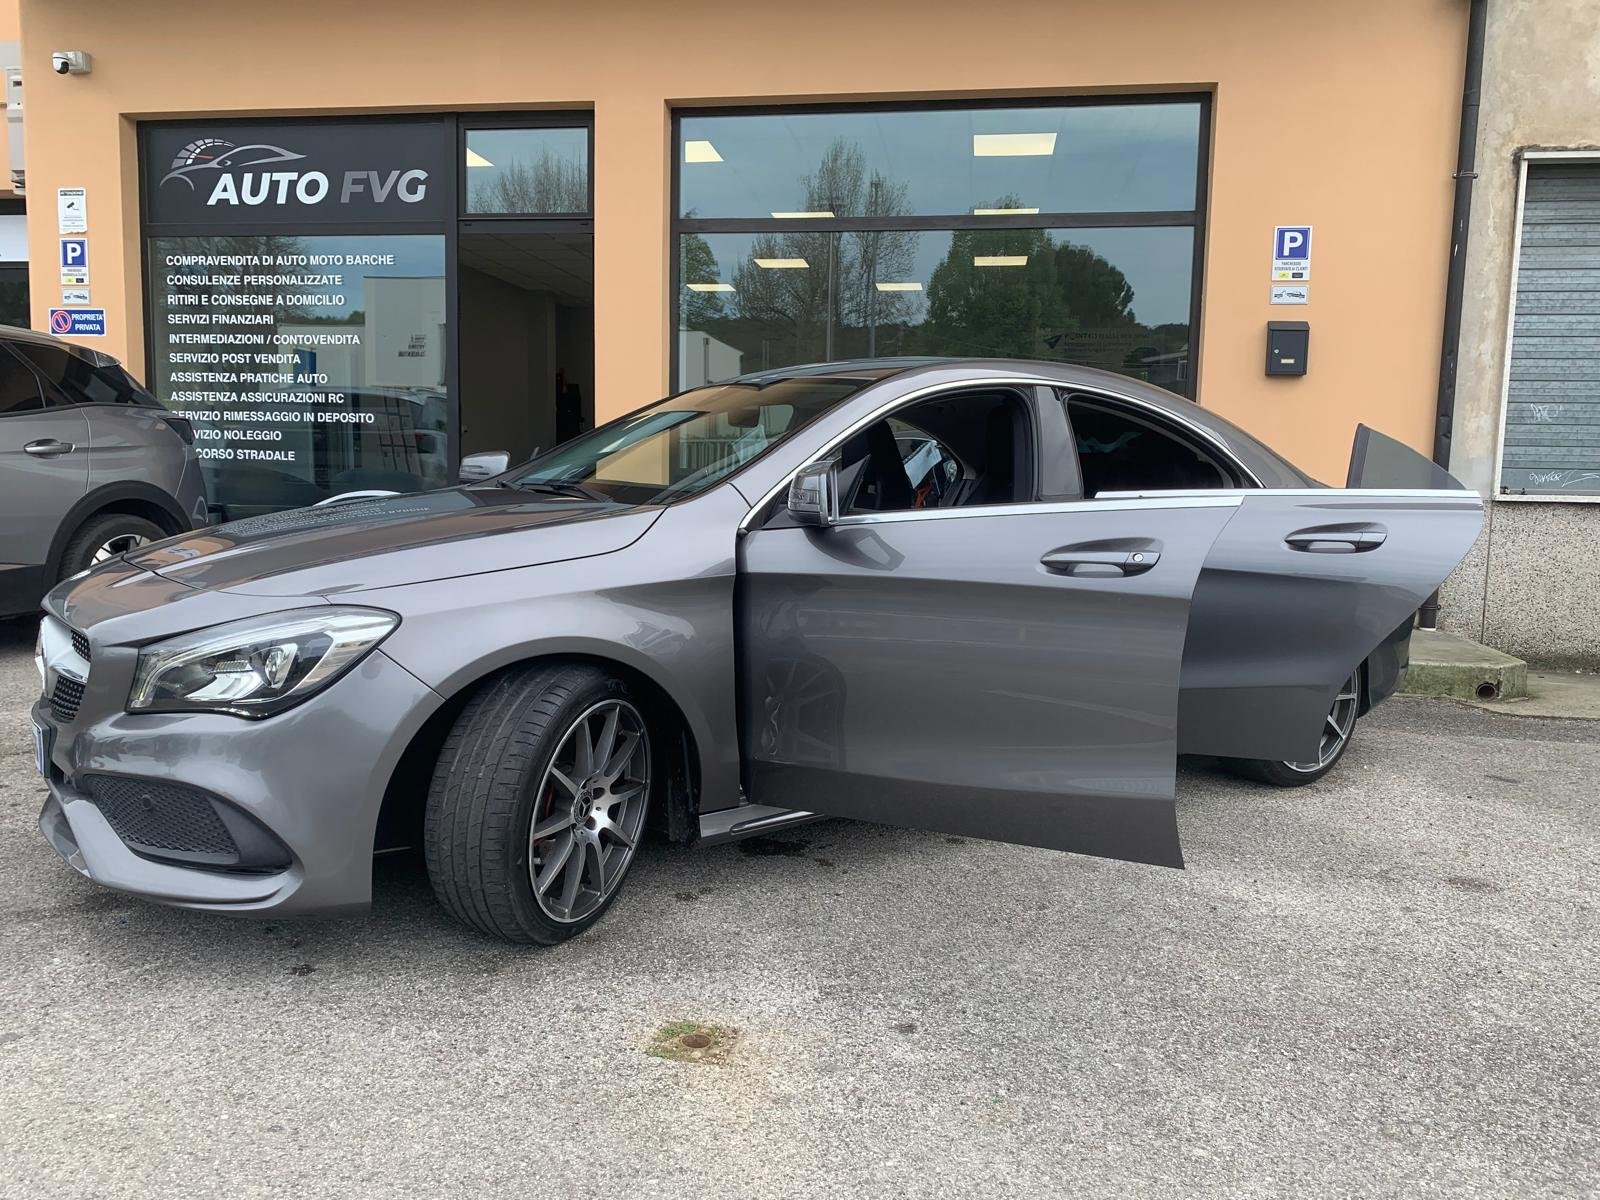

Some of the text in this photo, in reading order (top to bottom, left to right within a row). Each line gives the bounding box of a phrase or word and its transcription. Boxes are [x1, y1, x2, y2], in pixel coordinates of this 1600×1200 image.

[206, 169, 429, 206] AUTO FVG
[1283, 231, 1303, 256] P
[66, 243, 82, 264] P
[166, 254, 394, 266] COMPRAVENDITA DI AUTO MOTO BARCHE
[166, 275, 342, 286] CONSULENZE PERSONALIZZATE
[167, 294, 345, 305] RITIRI E CONSEGNE A DOMICILIO
[167, 314, 274, 325] SERVIZI FINANZIARI
[75, 323, 101, 331] PRIVATA
[169, 334, 264, 344] INTERMEDIAZIONI
[273, 334, 361, 345] CONTOVENDITA
[169, 353, 301, 364] SERVIZIO POST VENDITA
[170, 372, 328, 384] ASSISTENZA PRATICHE AUTO
[171, 391, 345, 404] ASSISTENZA ASSICURAZIONI RC
[223, 411, 301, 422] RIMESSAGGIO
[303, 412, 315, 422] IN
[317, 412, 375, 423] DEPOSITO
[193, 429, 282, 441] VIZIO NOLEGGIO
[237, 449, 296, 461] STRADALE
